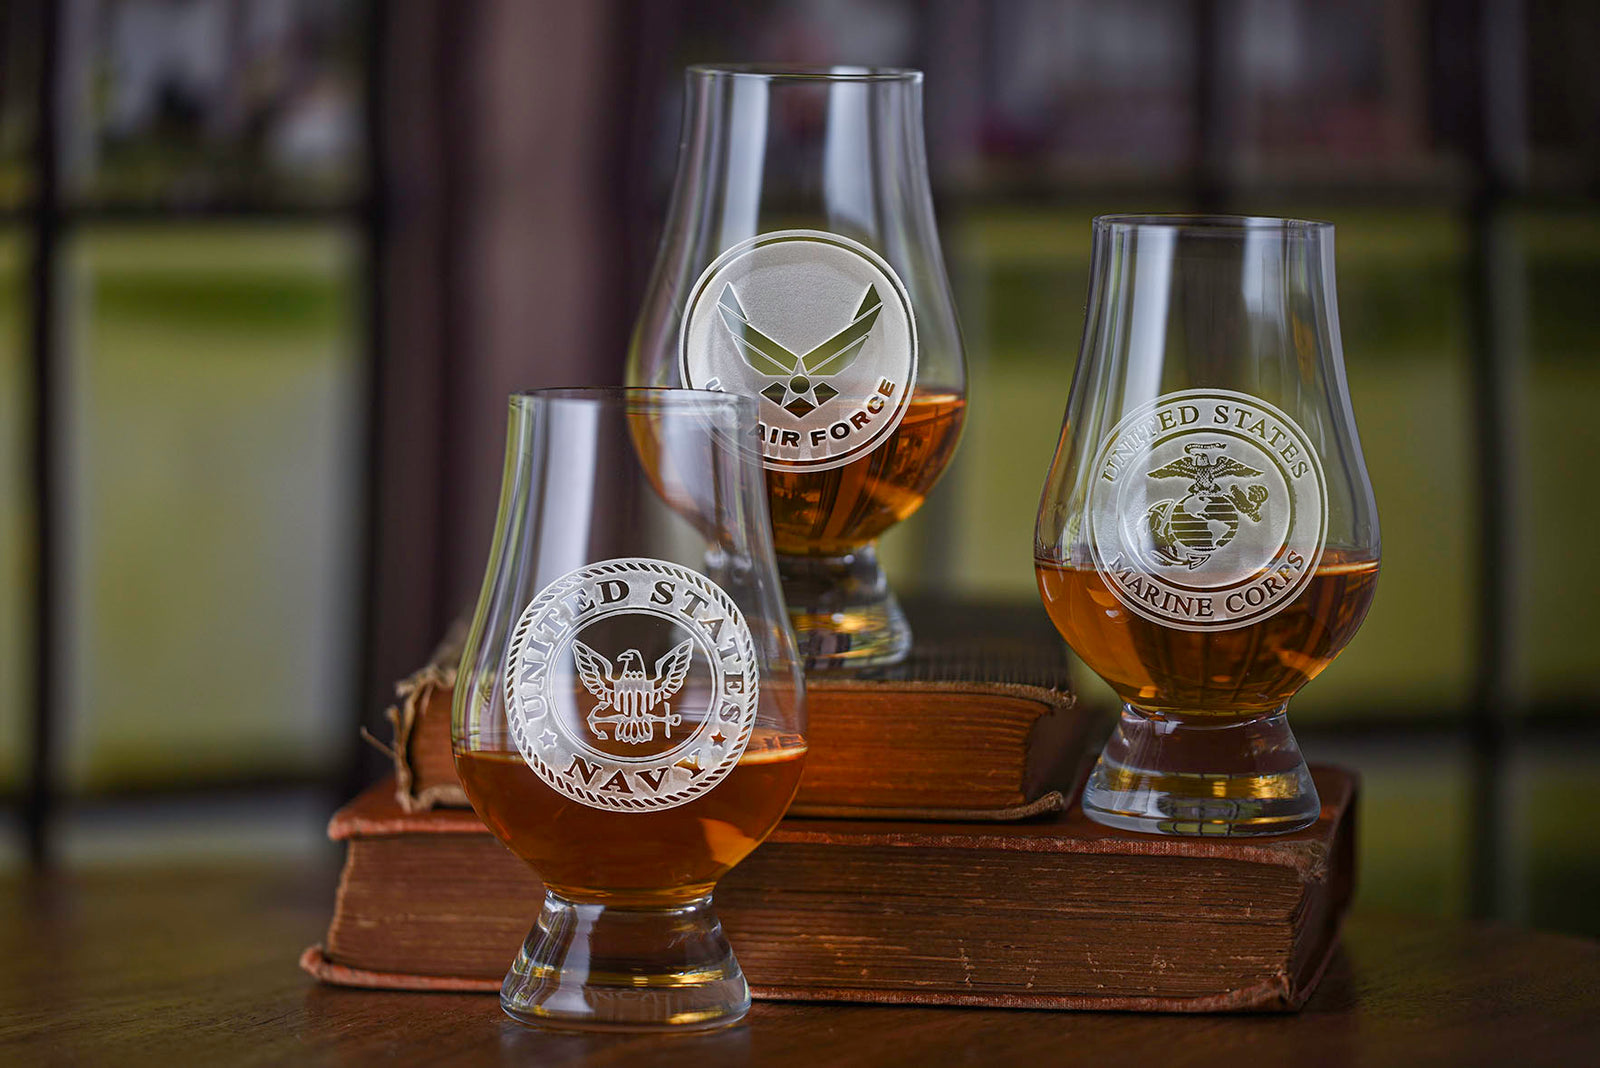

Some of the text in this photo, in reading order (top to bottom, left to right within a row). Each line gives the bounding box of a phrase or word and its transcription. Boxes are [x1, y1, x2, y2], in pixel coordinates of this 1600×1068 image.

[810, 378, 896, 447] FORCE
[1101, 405, 1309, 484] UNITED STATES
[1109, 550, 1305, 617] MARINE CORPS
[520, 579, 745, 724] UNITED STATES
[563, 748, 706, 793] NAVY
